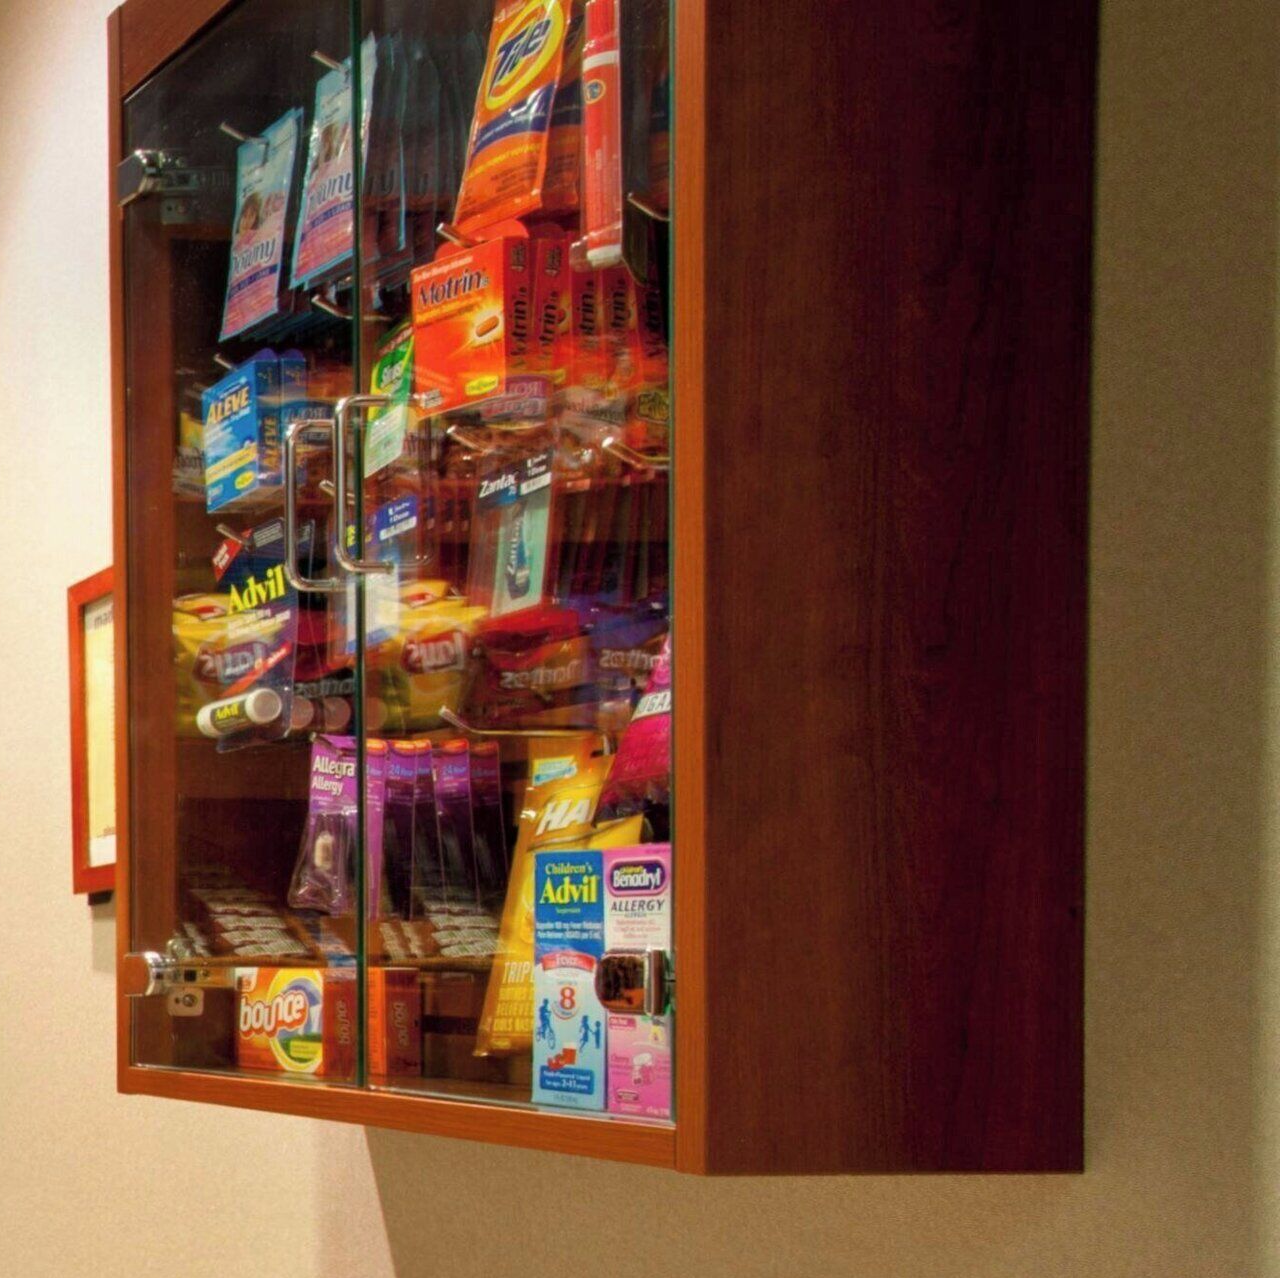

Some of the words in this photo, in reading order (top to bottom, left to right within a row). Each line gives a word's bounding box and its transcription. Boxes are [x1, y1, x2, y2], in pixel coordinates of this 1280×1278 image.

[491, 19, 551, 87] Tide
[419, 270, 482, 306] Motrin
[206, 387, 250, 427] ALEVE
[227, 564, 288, 617] Advil
[312, 755, 356, 779] Allegra
[311, 775, 344, 797] Allergy
[545, 862, 594, 876] Children's
[612, 867, 662, 891] Benadryl
[539, 875, 598, 904] Advil
[610, 899, 666, 913] ALLERGY
[239, 989, 307, 1033] bounce
[559, 985, 576, 1011] 8
